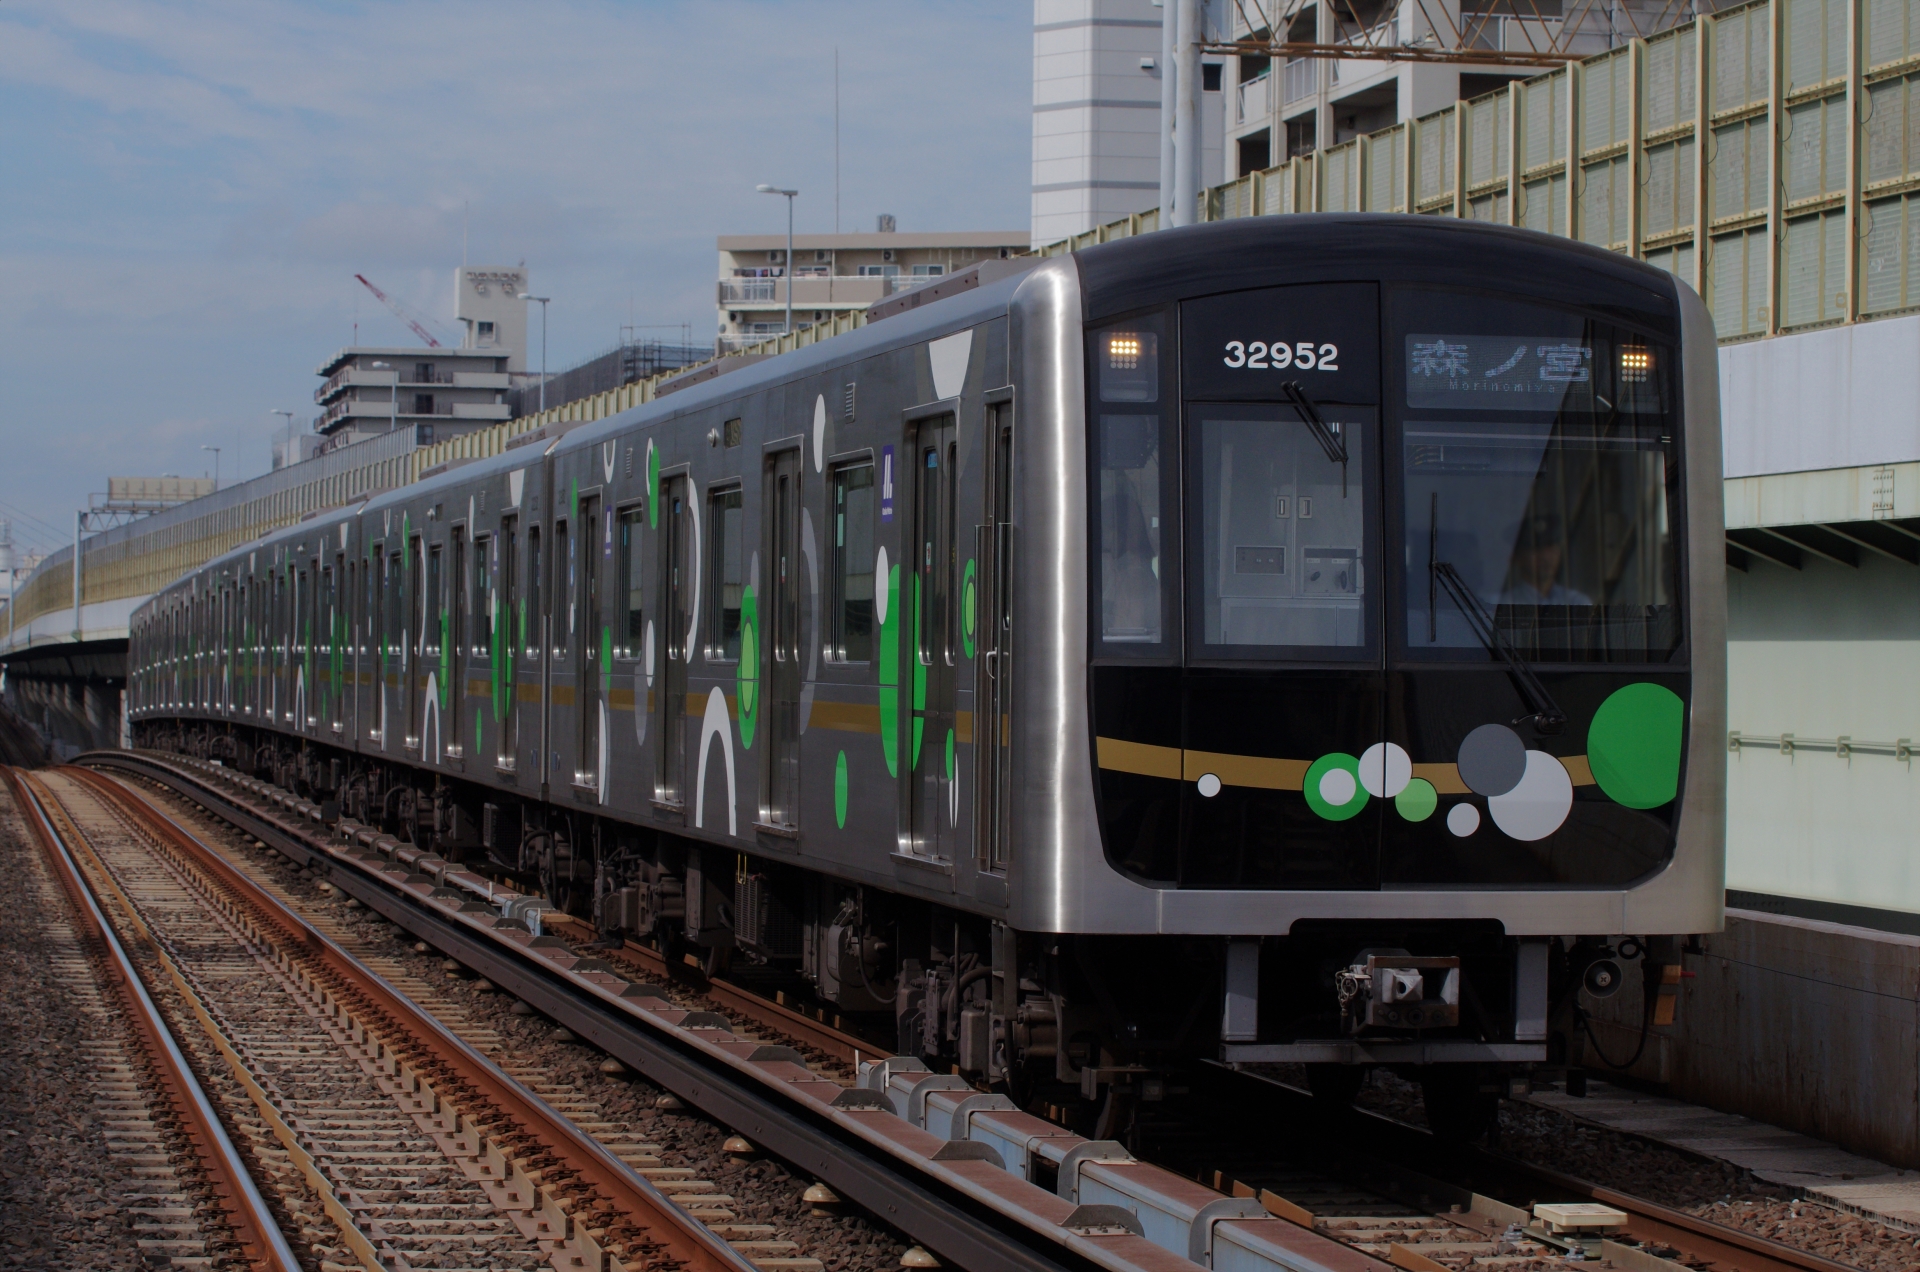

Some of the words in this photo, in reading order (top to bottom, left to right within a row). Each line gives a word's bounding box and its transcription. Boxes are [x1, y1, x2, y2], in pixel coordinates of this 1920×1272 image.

[1223, 340, 1339, 371] 32952
[1412, 339, 1592, 382] 森ノ宮
[1449, 380, 1556, 394] Morinomiya
